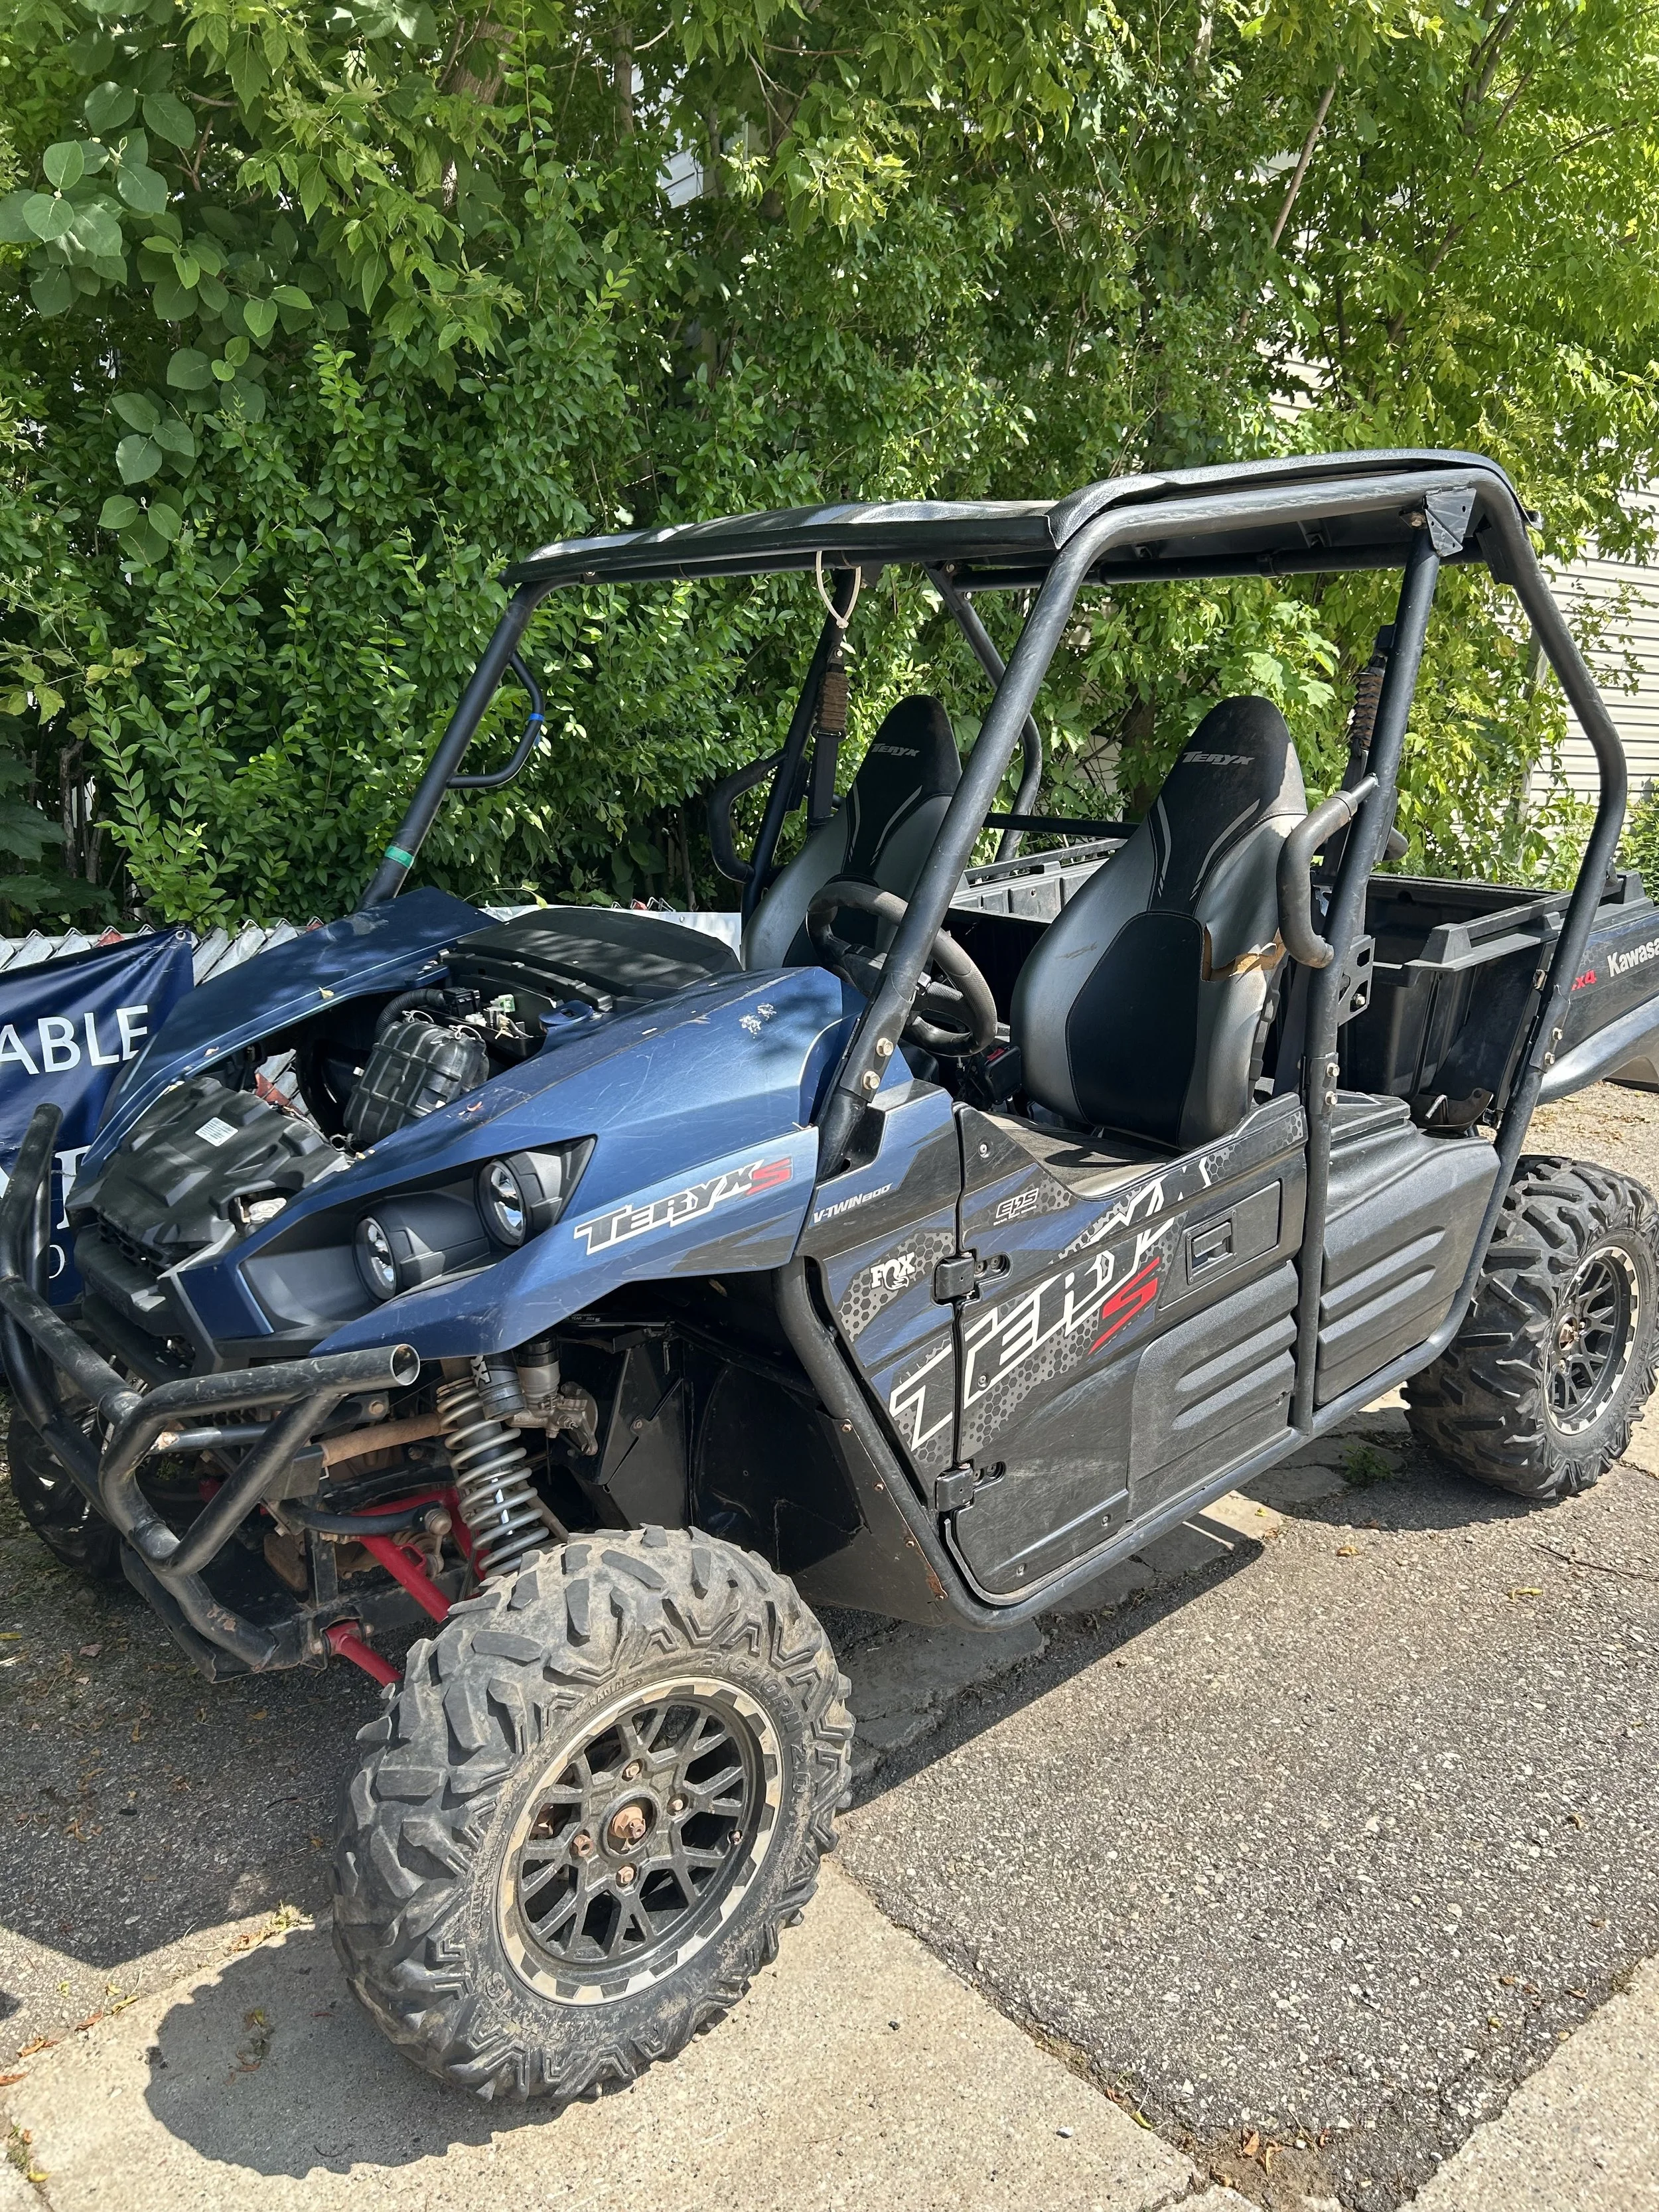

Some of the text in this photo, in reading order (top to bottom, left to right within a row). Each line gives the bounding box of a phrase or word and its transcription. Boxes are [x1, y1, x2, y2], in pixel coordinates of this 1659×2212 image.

[1182, 751, 1256, 765] TERYX
[1571, 969, 1597, 991] x4
[0, 1004, 148, 1074] ABLE
[995, 1187, 1039, 1219] EPS
[870, 1252, 915, 1290] FOX
